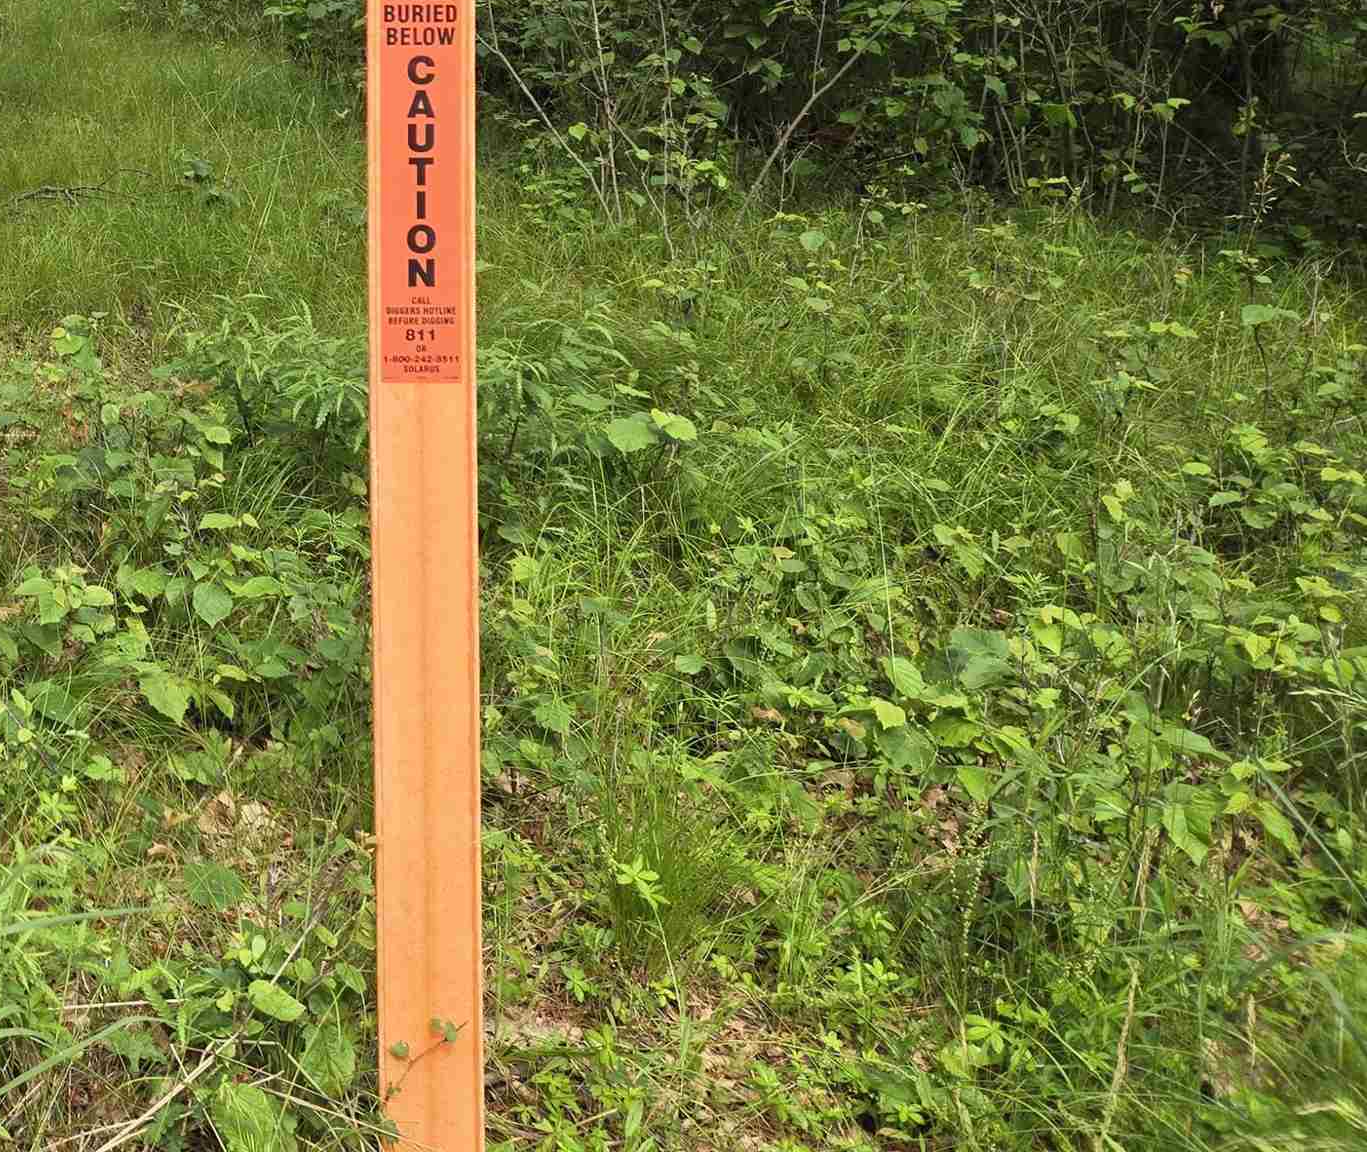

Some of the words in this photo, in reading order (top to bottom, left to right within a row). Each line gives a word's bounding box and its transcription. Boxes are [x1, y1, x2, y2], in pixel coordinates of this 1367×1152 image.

[383, 4, 457, 23] BURIED
[386, 27, 455, 46] BELOW
[406, 55, 436, 287] CAUTION
[411, 296, 431, 305] CALL
[423, 307, 457, 315] HOTLINE
[388, 316, 419, 325] BEFORE
[405, 329, 435, 341] 811
[416, 344, 427, 352] OR
